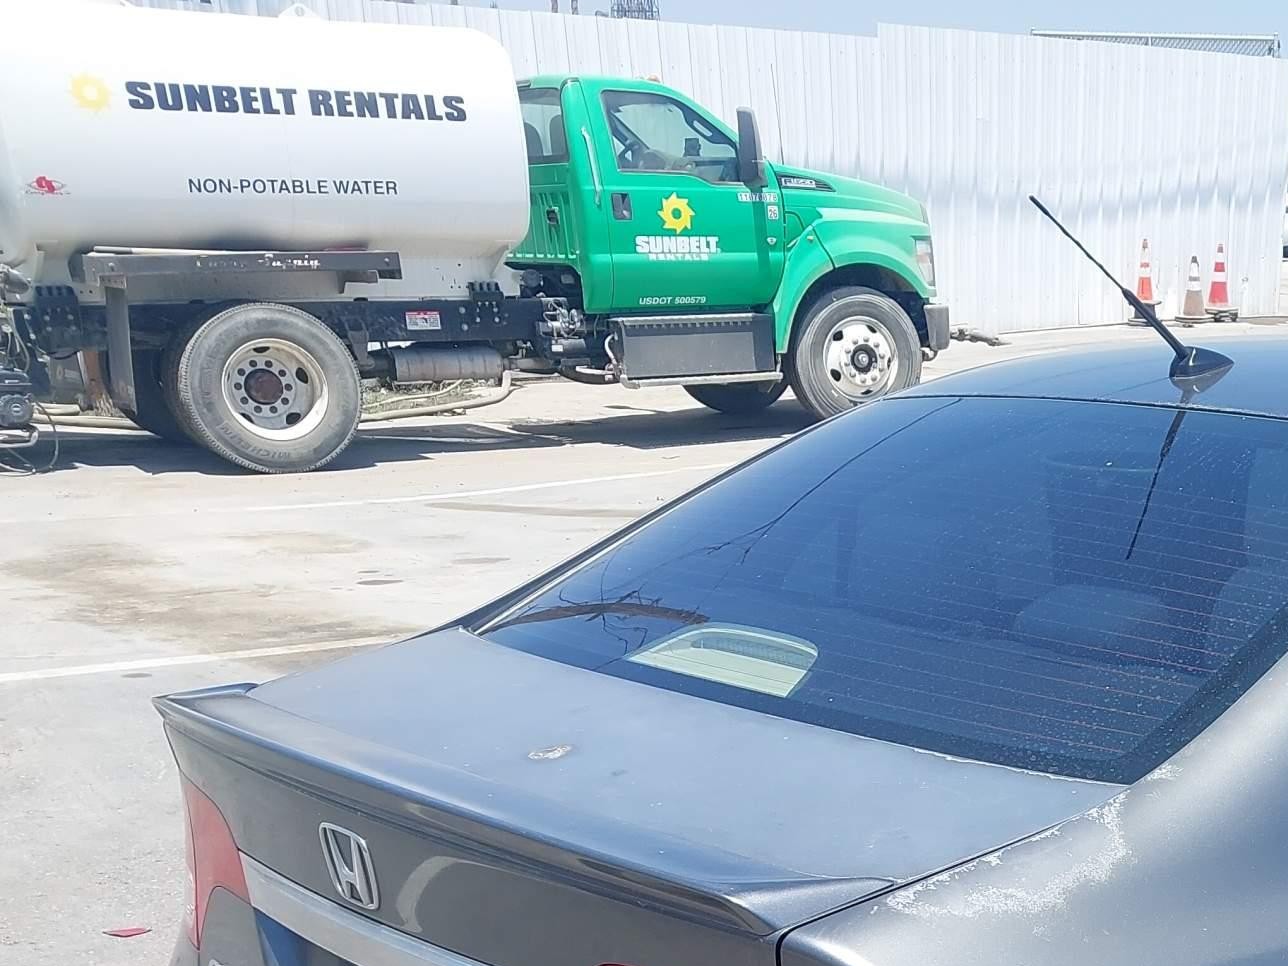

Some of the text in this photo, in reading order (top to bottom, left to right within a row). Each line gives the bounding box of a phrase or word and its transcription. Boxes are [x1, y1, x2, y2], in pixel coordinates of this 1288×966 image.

[125, 81, 467, 122] SUNBELT RENTALS
[188, 178, 398, 195] NON-POTABLE WATER
[768, 207, 778, 219] 26
[635, 235, 719, 253] SUNBELT
[639, 296, 706, 305] USDOT 500579
